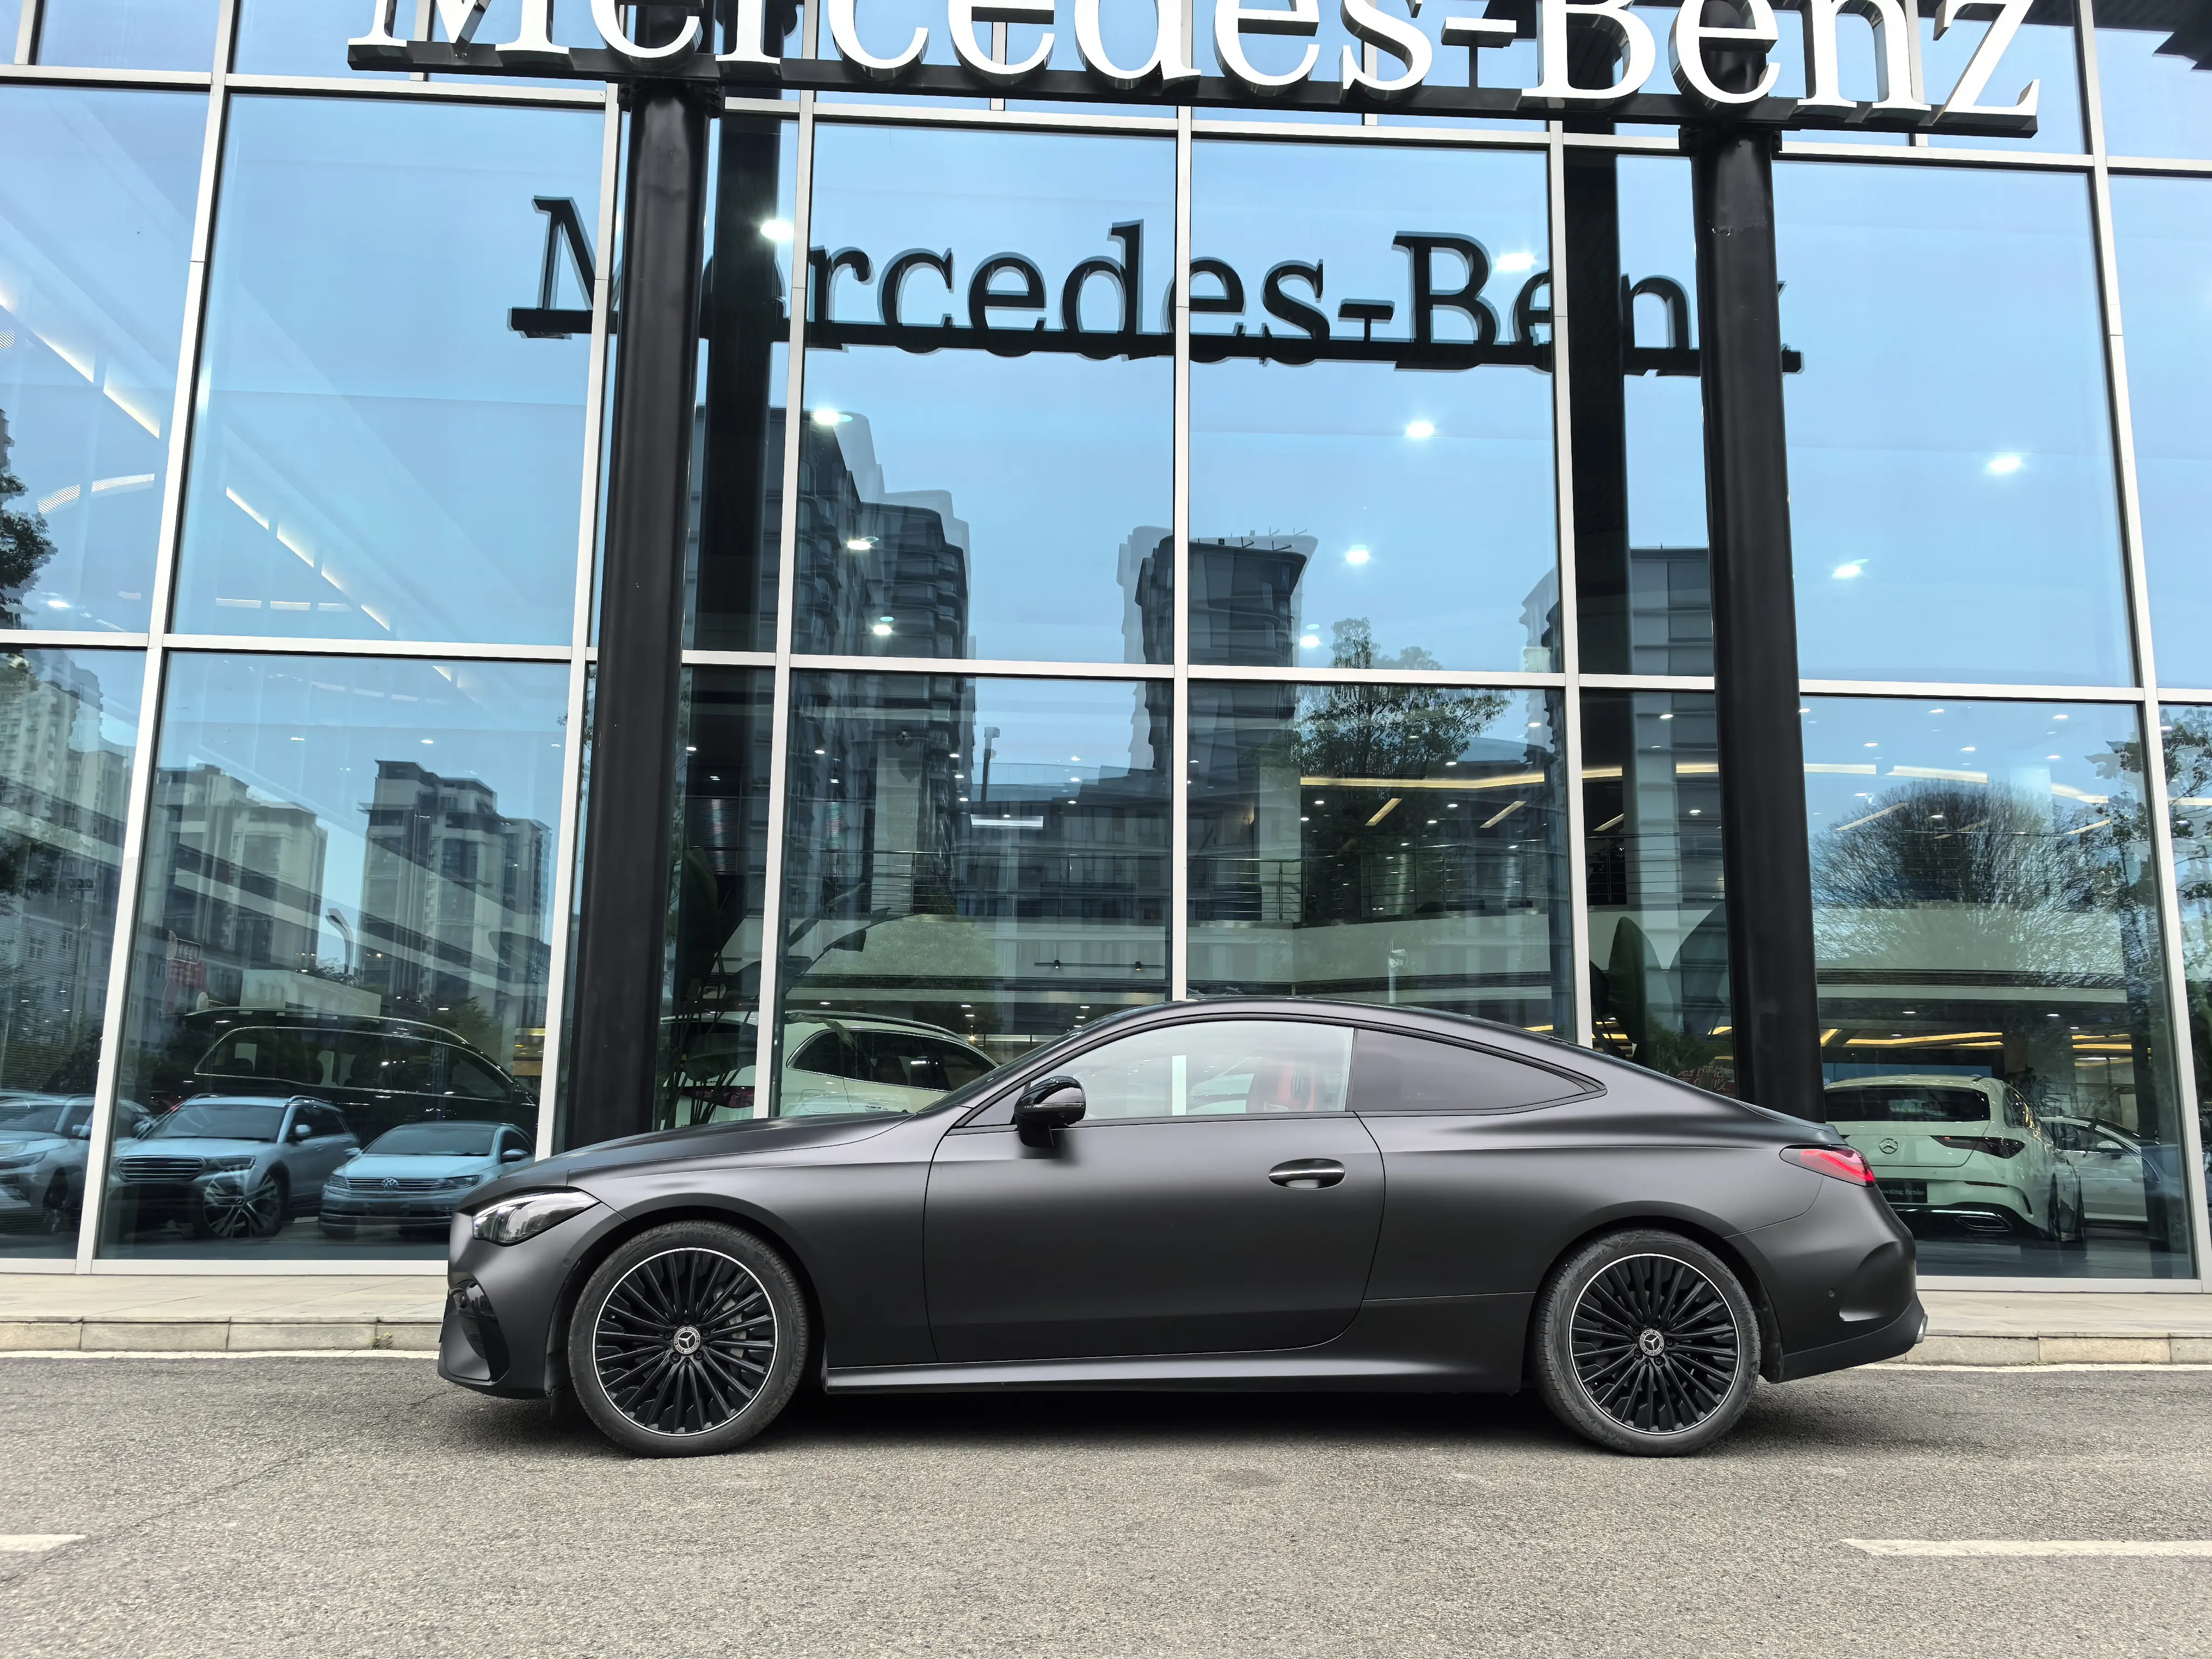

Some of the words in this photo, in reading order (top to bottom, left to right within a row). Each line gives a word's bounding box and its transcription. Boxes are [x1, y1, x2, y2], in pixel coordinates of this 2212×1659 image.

[348, 0, 2041, 117] cees-Benz
[522, 194, 1791, 377] rcedes-Bn
[1569, 1252, 1603, 1285] EcoContact
